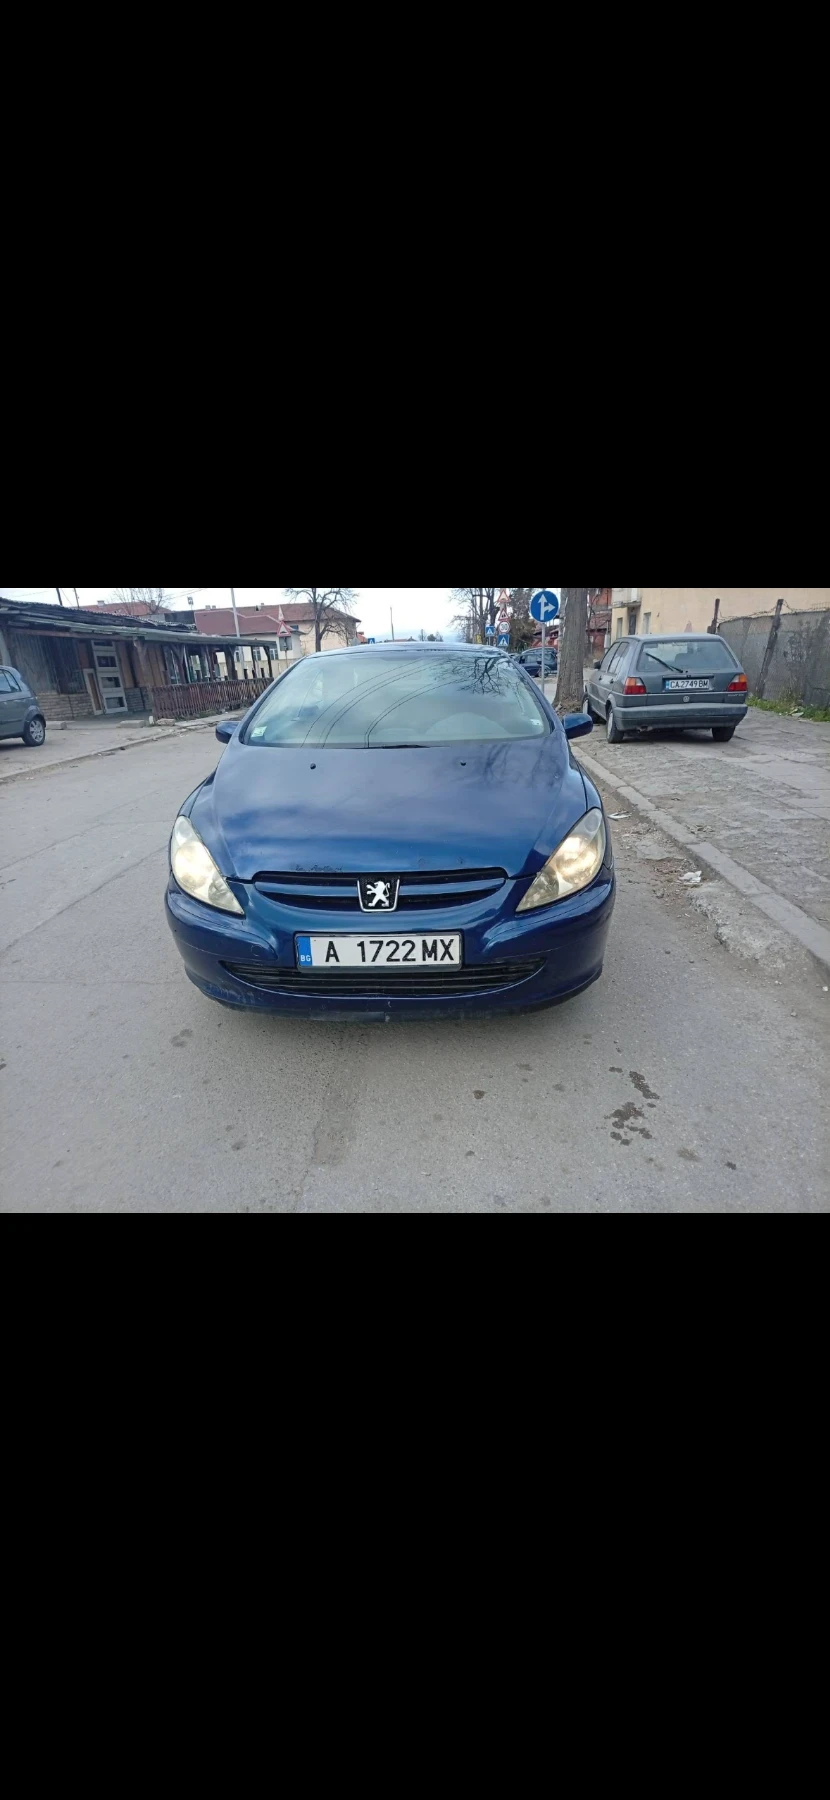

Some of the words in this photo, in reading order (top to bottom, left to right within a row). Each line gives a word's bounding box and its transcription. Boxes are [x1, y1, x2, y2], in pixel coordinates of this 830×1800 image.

[300, 954, 311, 962] BG
[325, 941, 340, 962] A
[357, 940, 416, 962] 1722
[422, 939, 454, 962] MX
